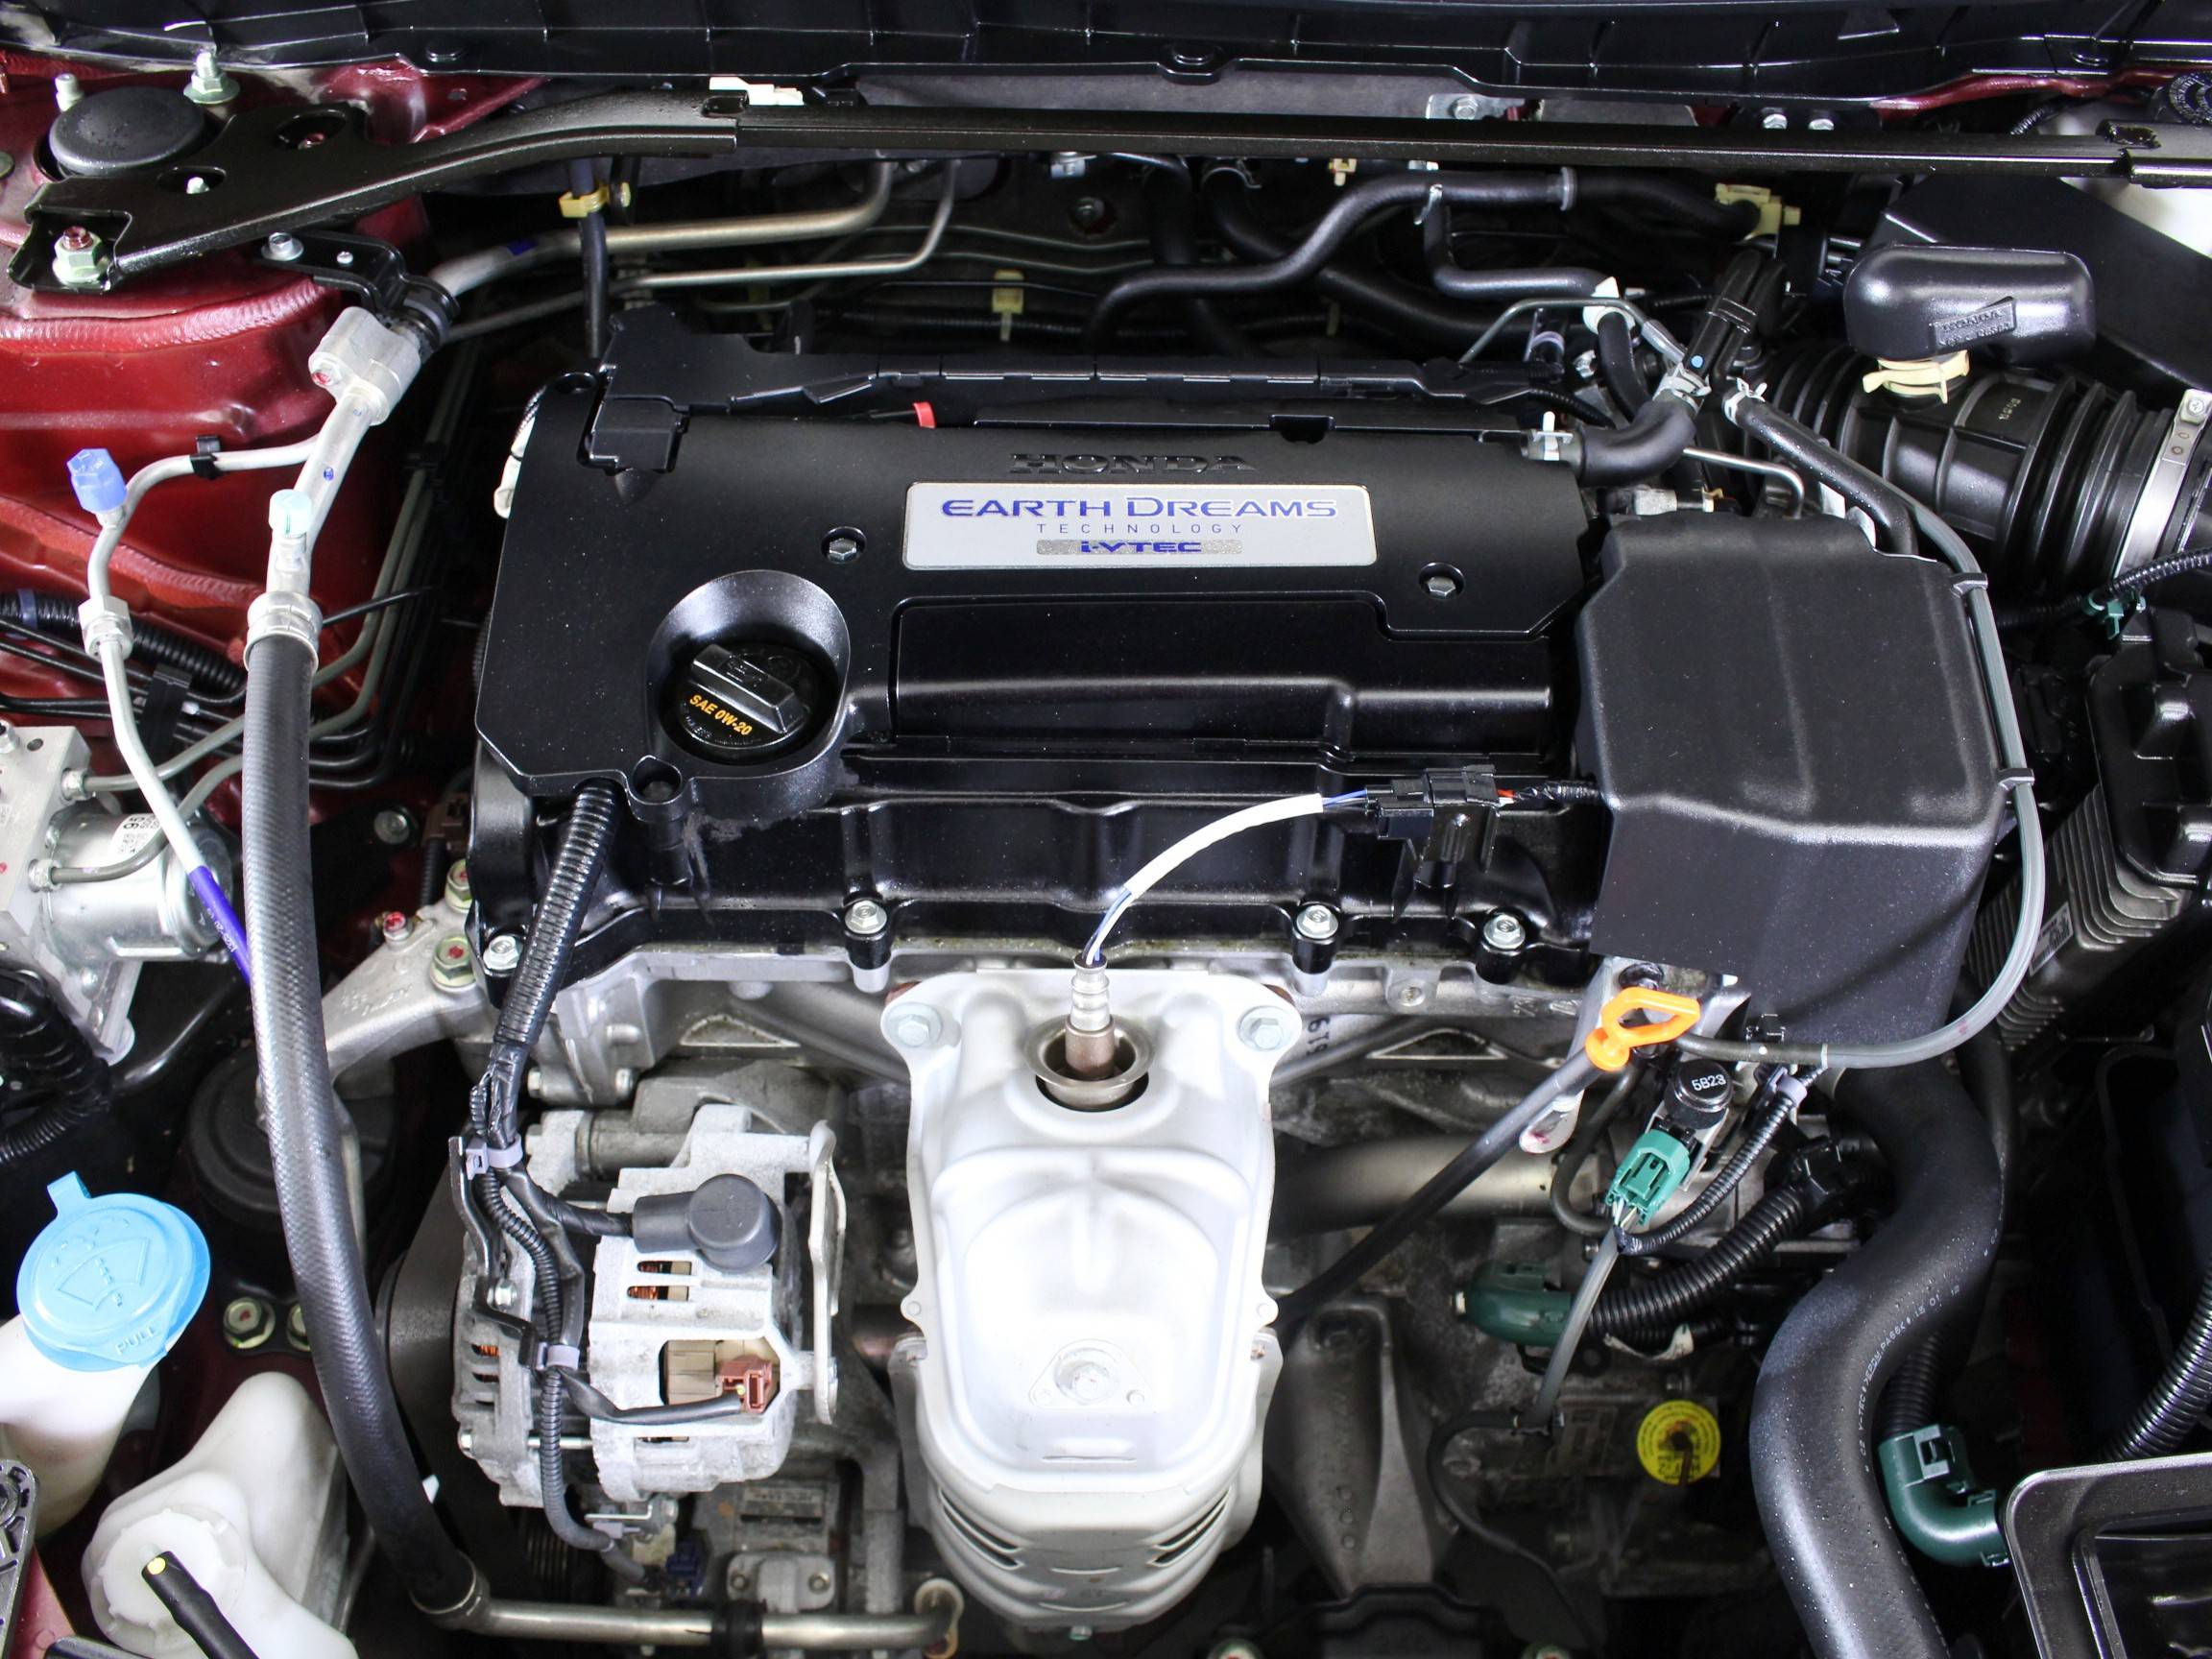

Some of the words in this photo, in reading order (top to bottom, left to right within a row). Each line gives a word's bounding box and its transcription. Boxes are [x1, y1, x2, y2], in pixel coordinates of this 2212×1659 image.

[1008, 453, 1257, 474] HONDA
[942, 499, 1111, 517] EARTH
[1126, 496, 1338, 517] DREAMS
[1037, 523, 1243, 535] TECHNOLOGY
[1080, 540, 1202, 554] i-VTEC
[689, 694, 718, 715] SAE
[714, 709, 753, 736] 0W-20
[1691, 1073, 1727, 1092] 5B23
[114, 1326, 156, 1356] PULL
